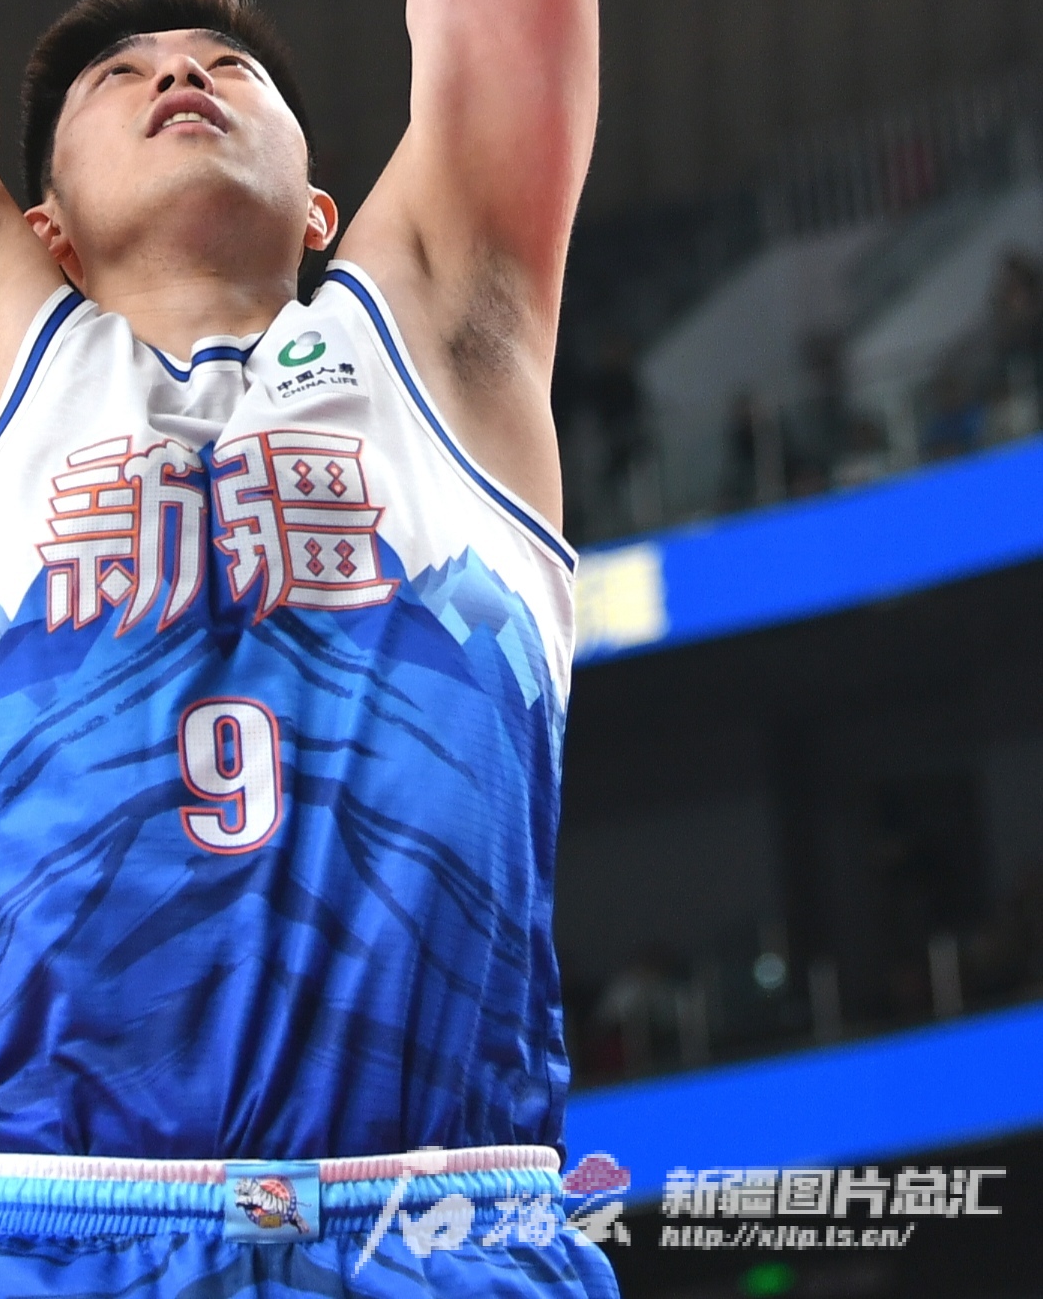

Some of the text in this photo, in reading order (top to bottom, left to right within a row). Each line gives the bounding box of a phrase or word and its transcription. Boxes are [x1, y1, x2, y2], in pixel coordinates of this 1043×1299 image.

[277, 362, 355, 392] 中国人寿
[281, 376, 359, 399] CHINA LIFE
[35, 429, 400, 638] 新疆
[178, 696, 283, 856] 9
